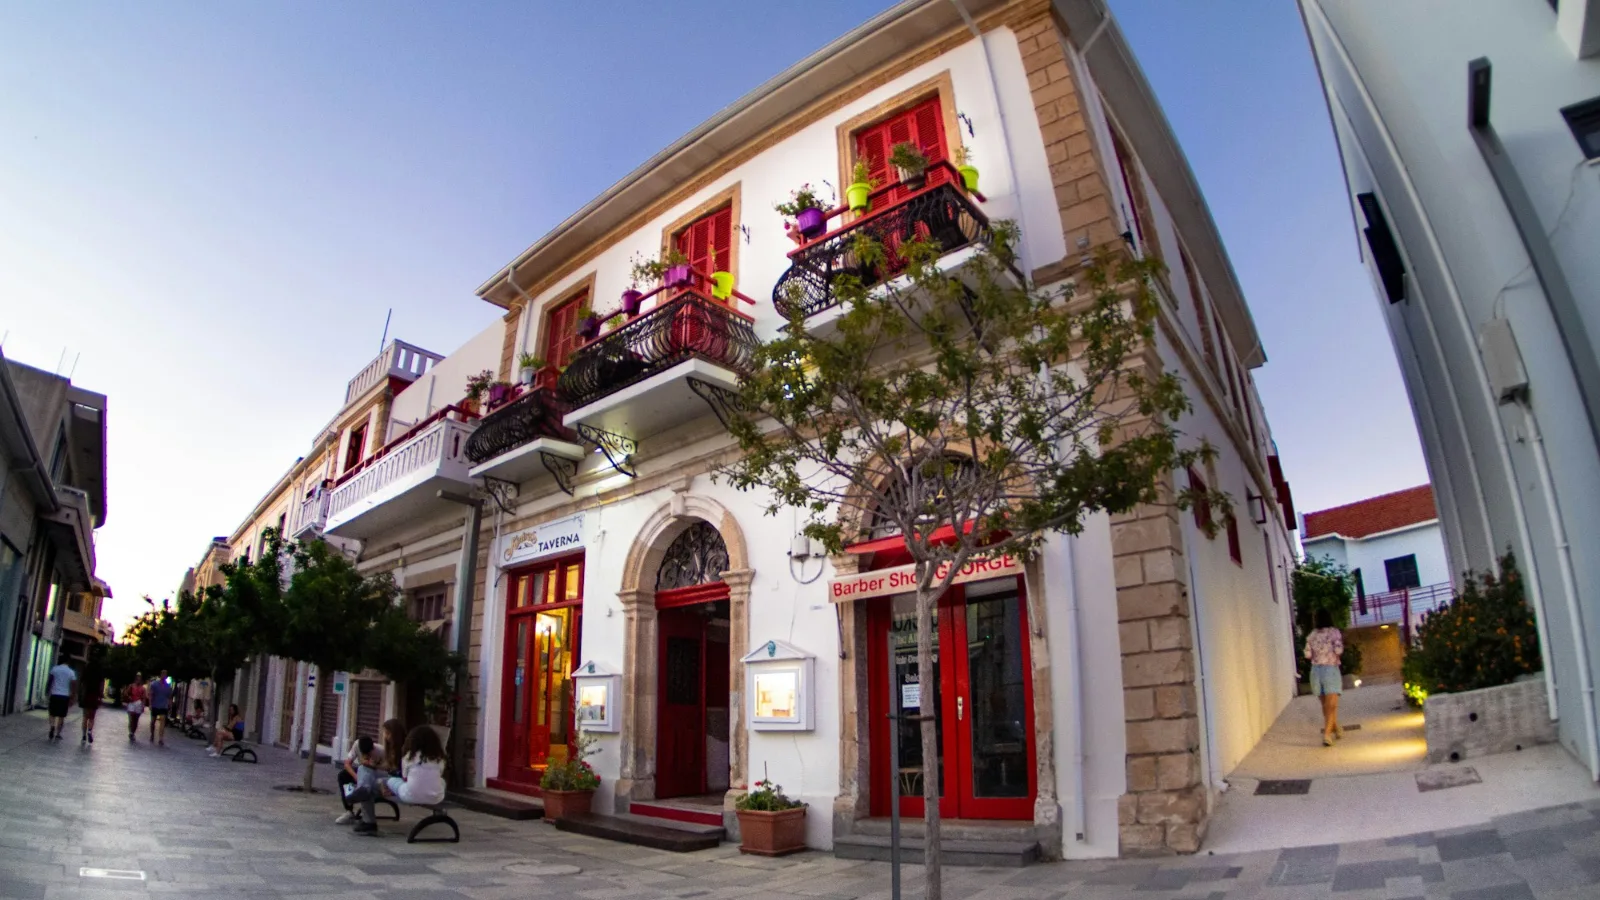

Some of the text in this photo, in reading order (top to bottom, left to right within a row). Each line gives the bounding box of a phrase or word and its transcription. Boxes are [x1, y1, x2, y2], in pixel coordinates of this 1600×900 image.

[538, 533, 580, 552] TAVERNA
[833, 578, 885, 597] Barber
[889, 570, 924, 588] Sho
